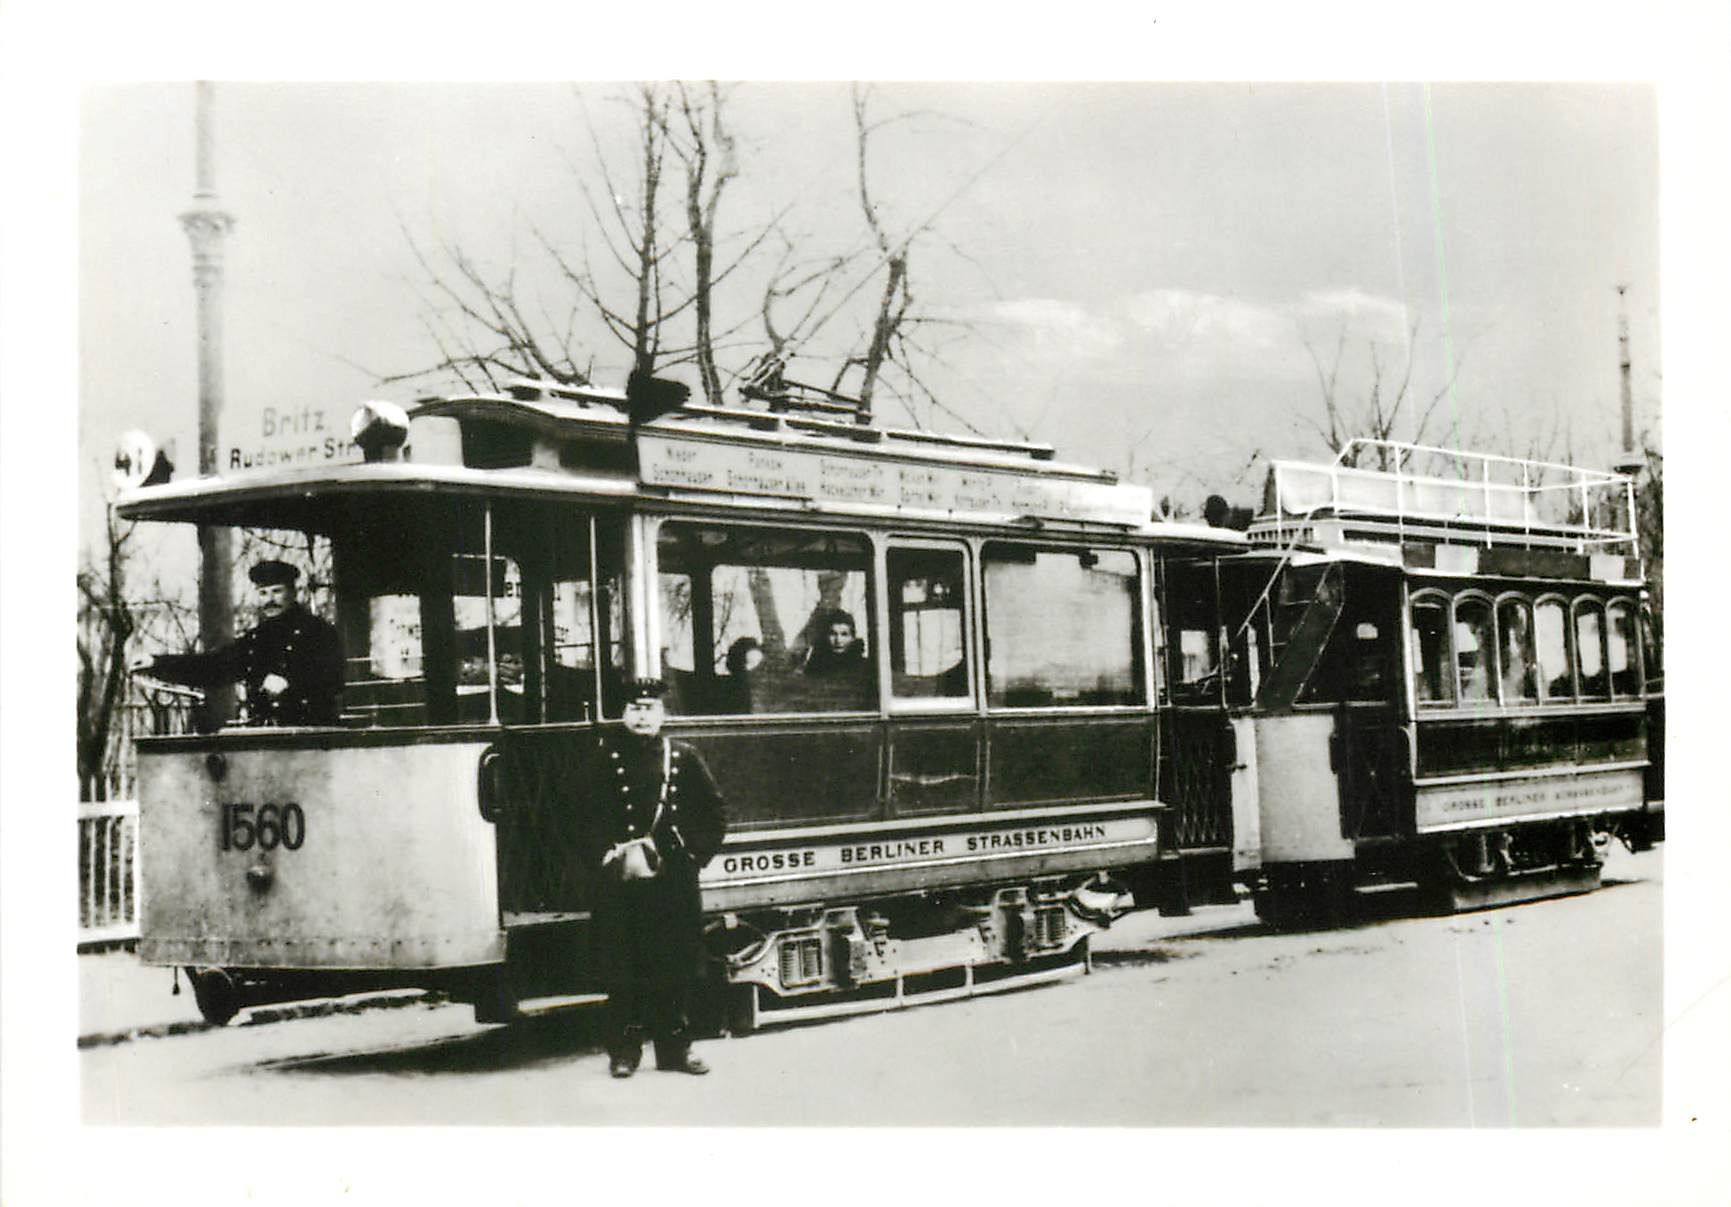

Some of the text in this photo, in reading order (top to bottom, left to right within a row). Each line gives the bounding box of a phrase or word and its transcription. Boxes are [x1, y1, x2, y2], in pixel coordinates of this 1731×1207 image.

[221, 802, 305, 851] 1560
[724, 824, 1107, 874] GROSSE BERLINER STRASSENBAHN
